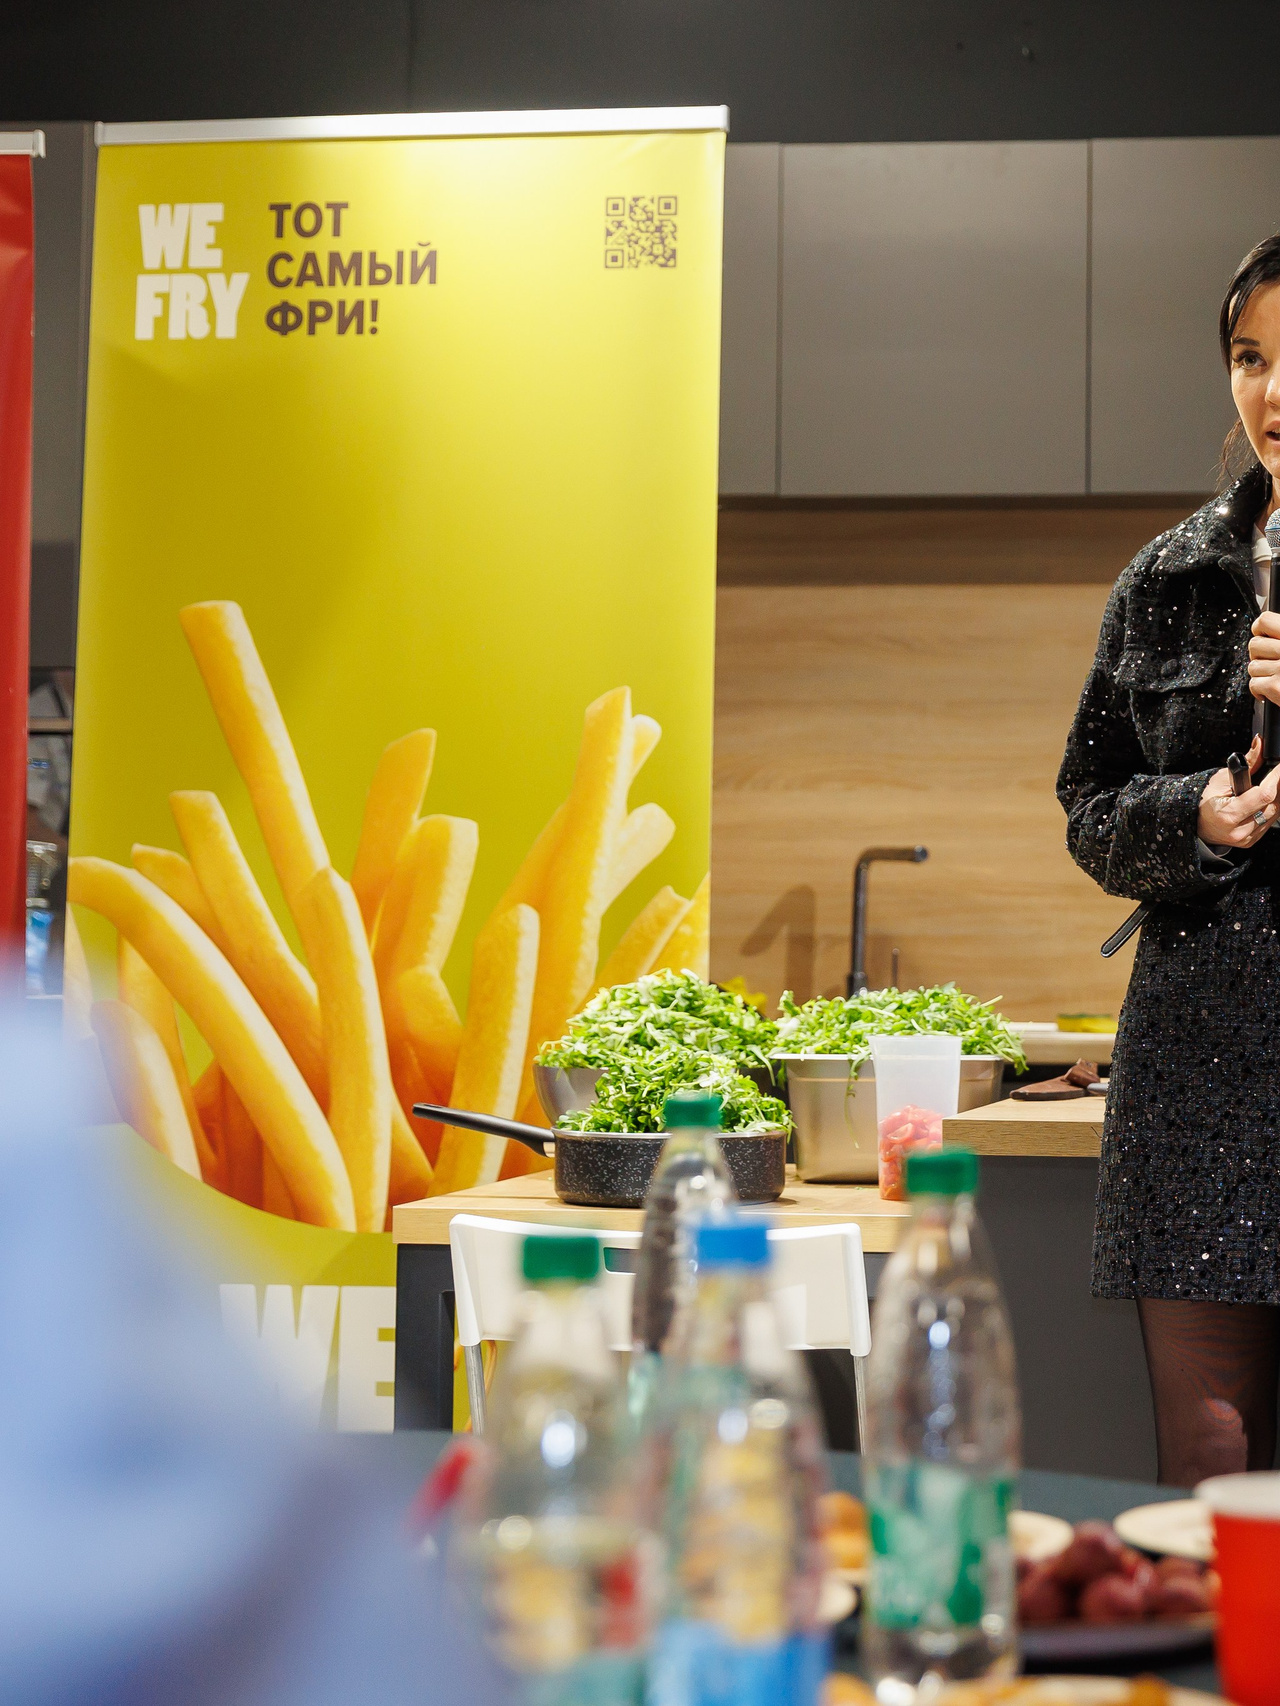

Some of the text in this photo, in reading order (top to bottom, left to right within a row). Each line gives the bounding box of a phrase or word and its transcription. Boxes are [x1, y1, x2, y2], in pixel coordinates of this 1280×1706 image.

[138, 203, 224, 269] WE
[269, 202, 349, 238] ТОТ
[266, 242, 438, 288] САМЫЙ
[135, 272, 250, 340] FRY
[265, 299, 379, 336] ФРИ!
